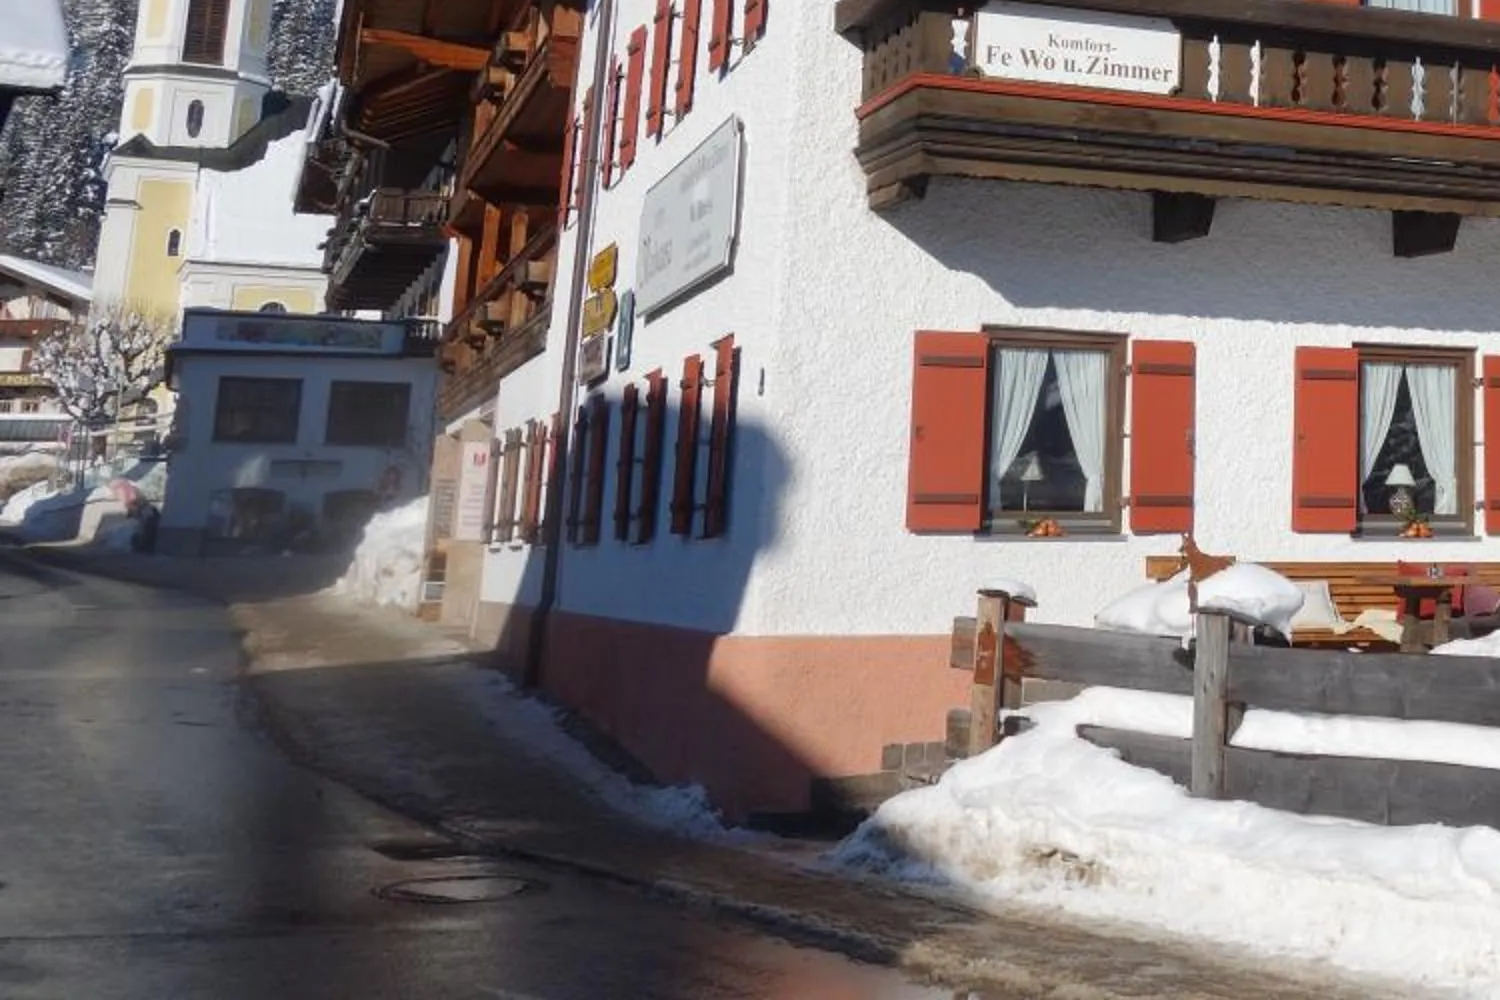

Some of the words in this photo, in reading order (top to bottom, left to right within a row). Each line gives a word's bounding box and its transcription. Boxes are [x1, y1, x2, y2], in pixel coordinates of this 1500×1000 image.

[1048, 33, 1118, 53] Komfort-
[986, 44, 1012, 67] Fe
[1020, 47, 1055, 71] Wo
